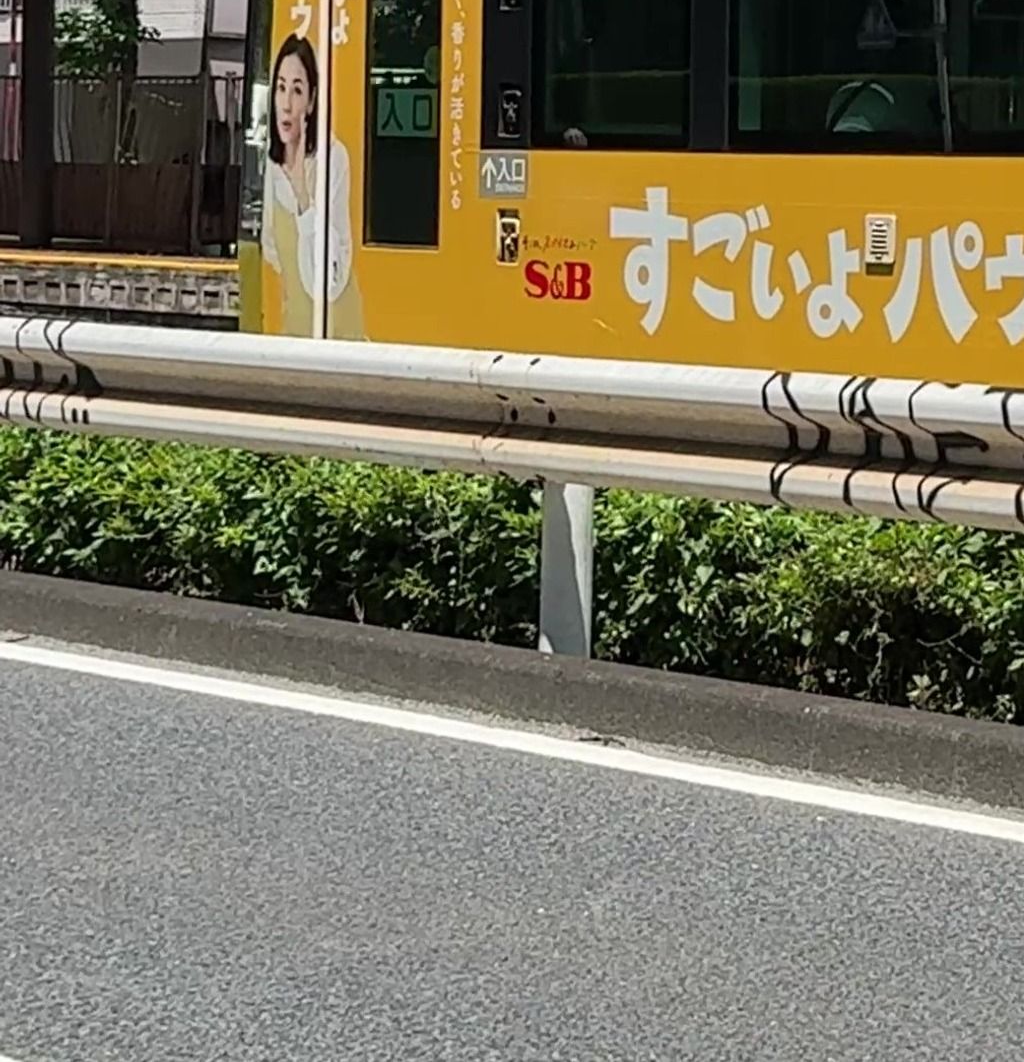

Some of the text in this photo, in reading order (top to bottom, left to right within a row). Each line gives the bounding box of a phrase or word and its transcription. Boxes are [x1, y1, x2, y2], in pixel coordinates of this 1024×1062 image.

[382, 92, 433, 131] 入口
[497, 157, 526, 182] 入口
[524, 259, 592, 301] S&B
